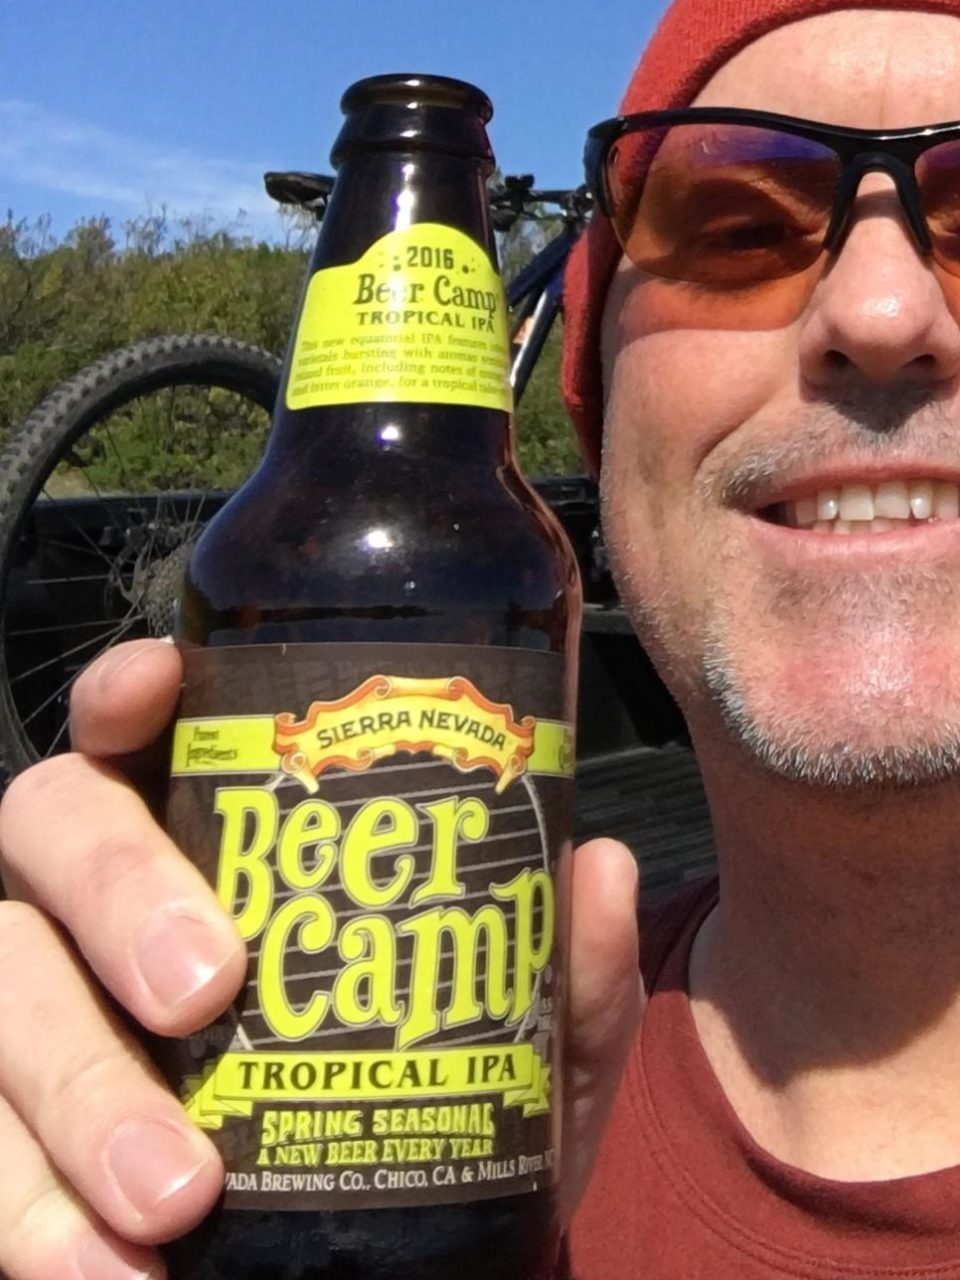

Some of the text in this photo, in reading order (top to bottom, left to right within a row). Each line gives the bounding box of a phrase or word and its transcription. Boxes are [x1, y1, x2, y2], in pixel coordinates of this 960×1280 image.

[406, 246, 454, 269] 2016
[353, 273, 496, 319] Beer Camp
[356, 311, 495, 334] TROPICAL IPA
[404, 347, 432, 359] with
[422, 333, 442, 345] IPA
[361, 361, 425, 376] including
[430, 364, 463, 375] notes
[399, 376, 417, 388] for
[421, 380, 430, 389] a
[432, 379, 478, 393] tropical
[316, 708, 507, 752] SIERRA NEVADA
[214, 787, 490, 942] Beer
[257, 867, 555, 1051] Camp
[238, 1053, 517, 1091] TROPICAL IPA
[261, 1103, 496, 1148] SPRING SEASONAL
[256, 1137, 494, 1168] A NEW BEER EVERY YEAR
[260, 1170, 336, 1192] BREWING
[374, 1167, 429, 1190] CHICO,
[432, 1165, 457, 1186] CA
[460, 1166, 475, 1184] &
[477, 1158, 516, 1182] MILLS
